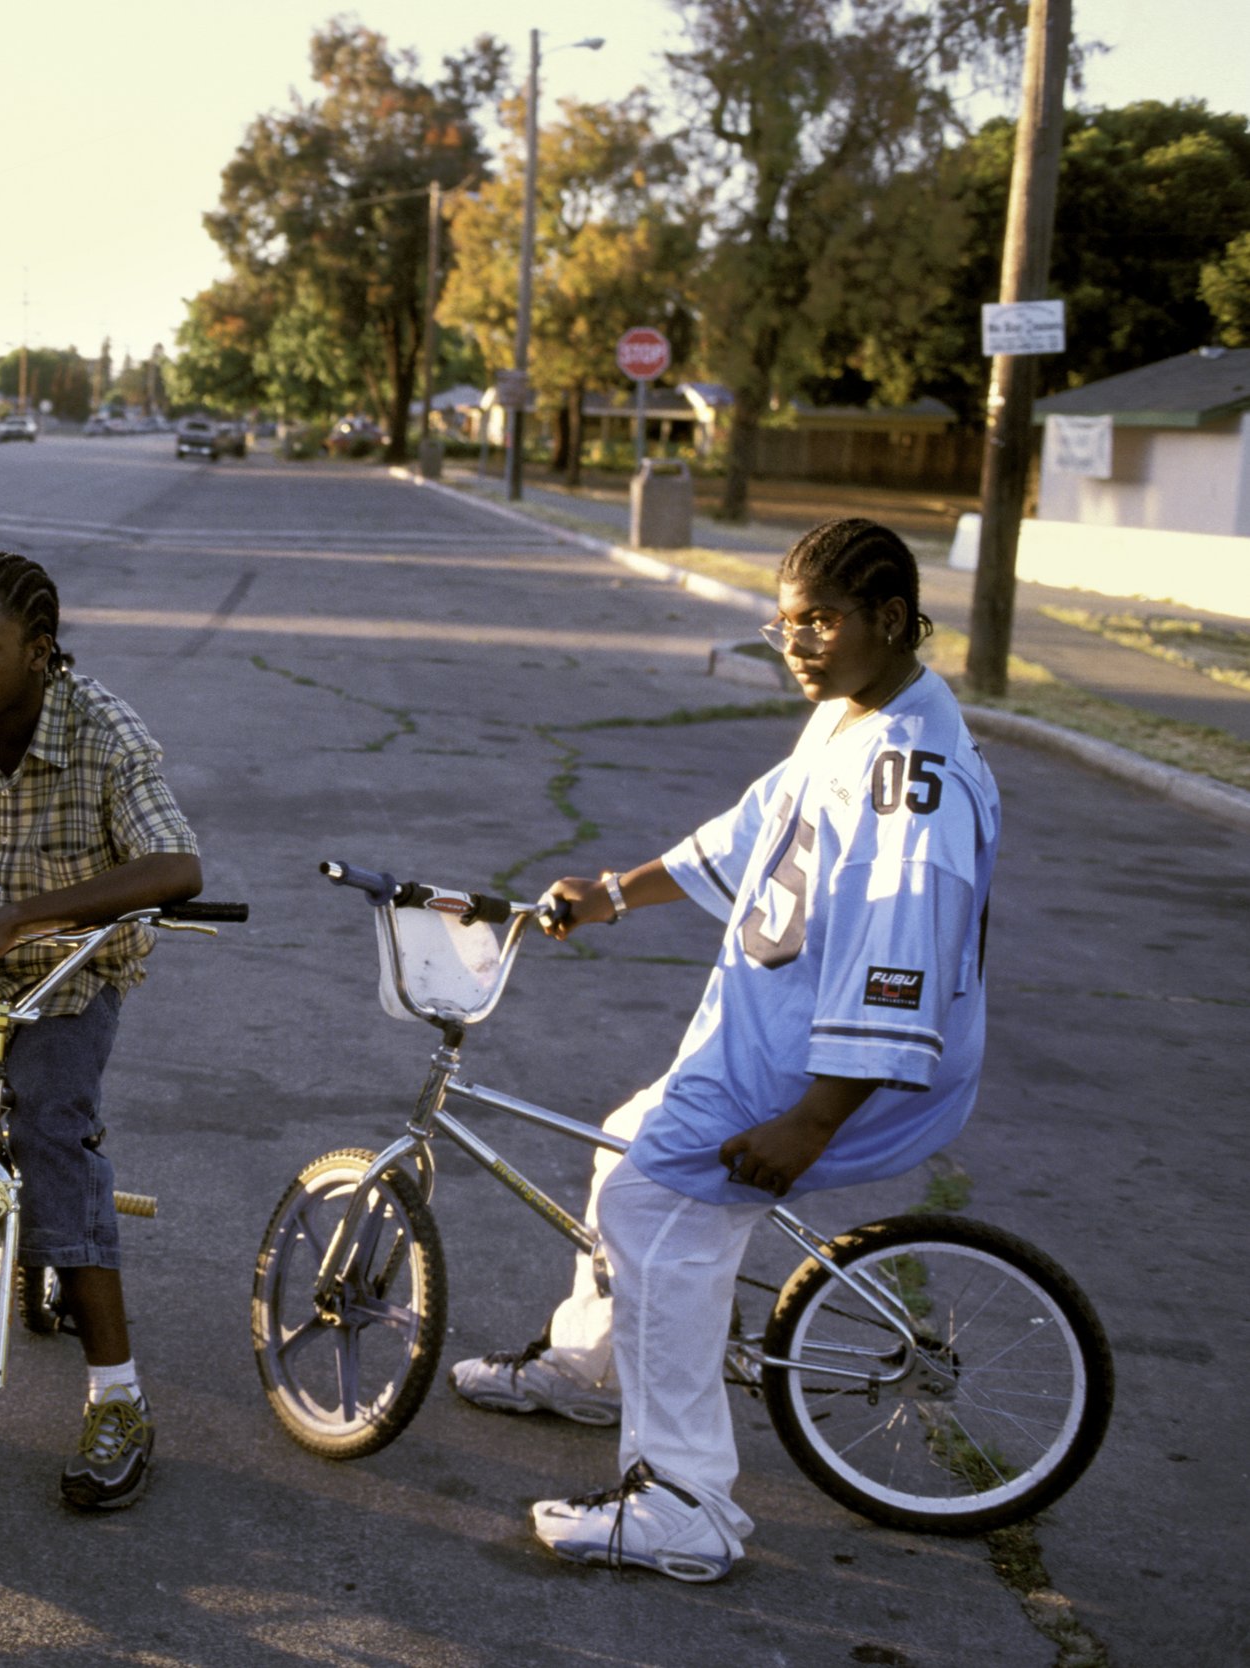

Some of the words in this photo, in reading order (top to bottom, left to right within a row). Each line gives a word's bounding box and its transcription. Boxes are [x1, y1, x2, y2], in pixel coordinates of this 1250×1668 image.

[620, 342, 664, 364] STOP
[871, 749, 946, 815] 05
[870, 971, 918, 986] FUBU
[493, 1160, 574, 1230] mongoose
